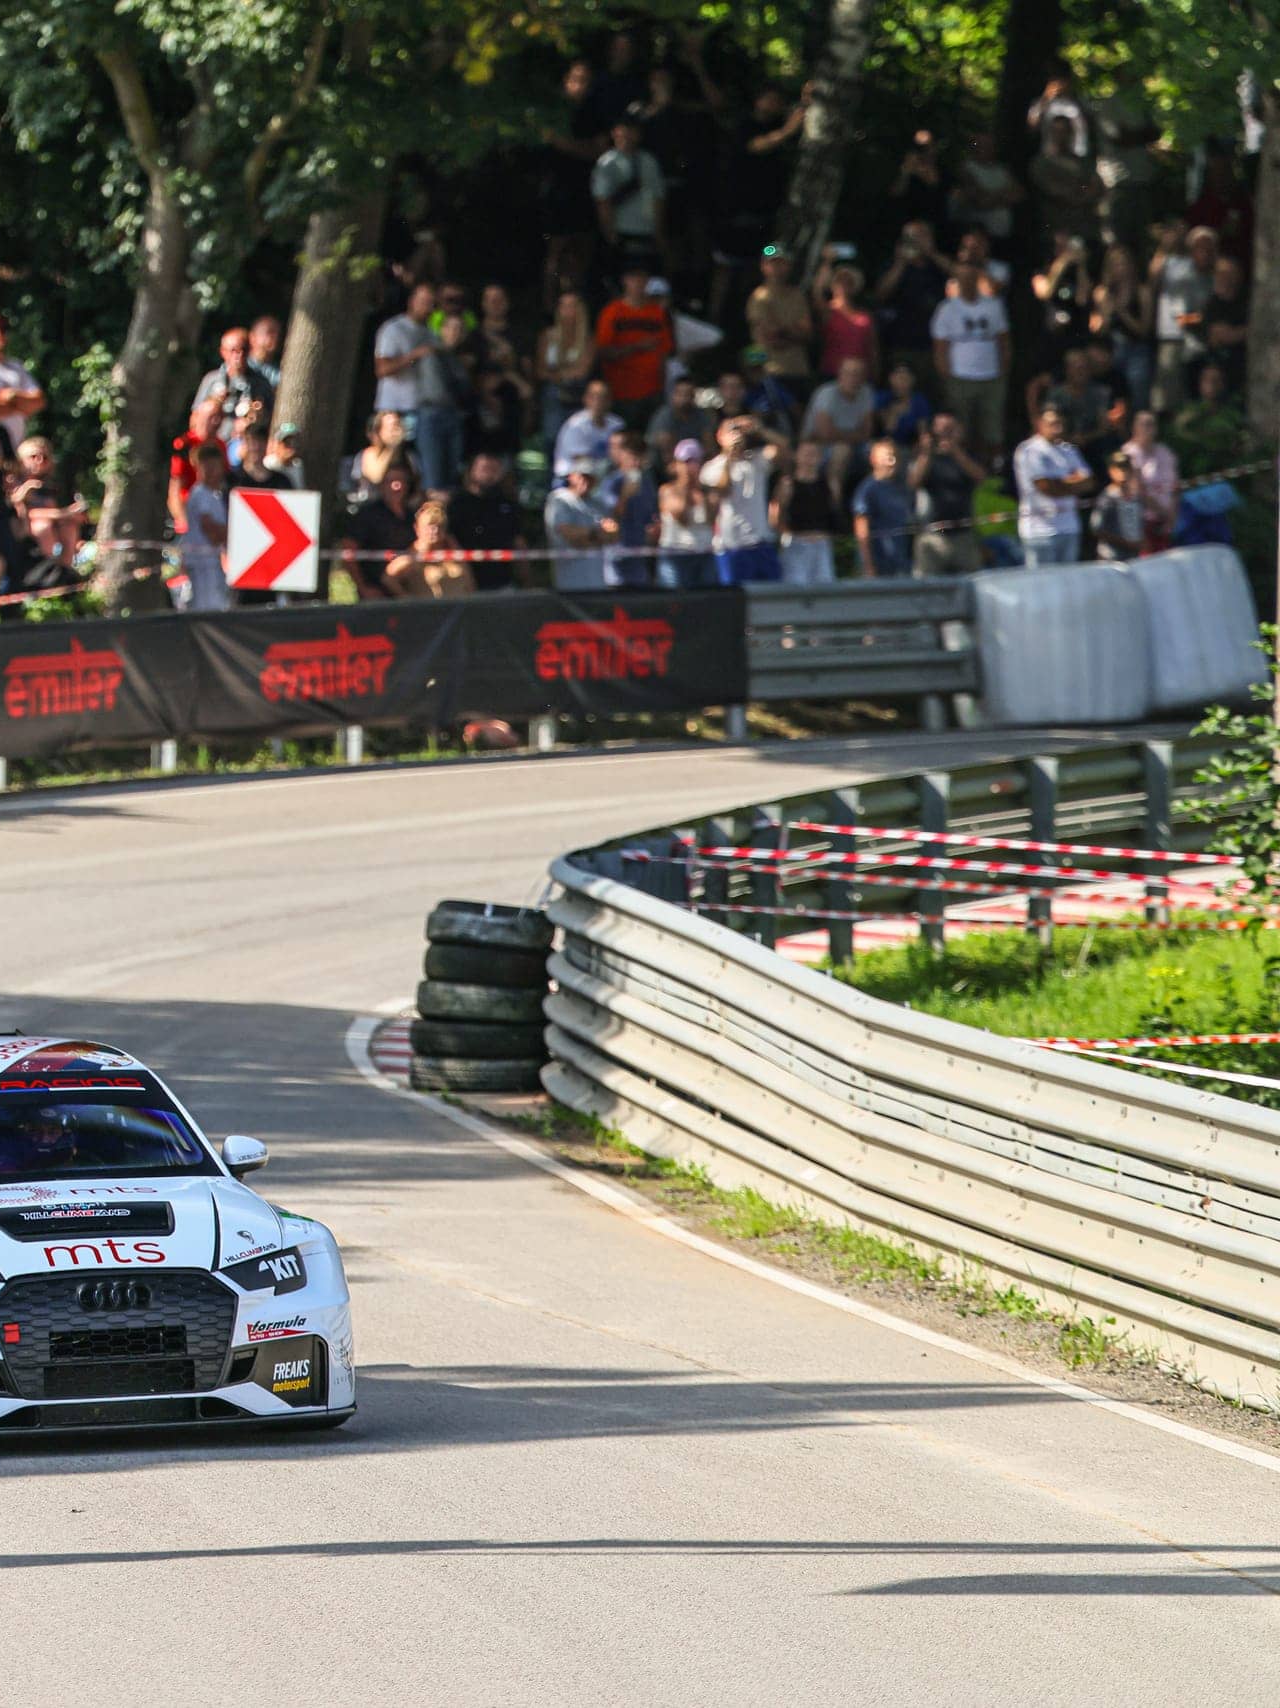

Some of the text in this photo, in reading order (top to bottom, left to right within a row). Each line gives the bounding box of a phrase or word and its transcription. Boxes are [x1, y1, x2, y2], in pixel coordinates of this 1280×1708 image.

[43, 1239, 166, 1268] mts
[268, 1254, 302, 1282] KIT
[251, 1315, 307, 1332] formula
[273, 1359, 311, 1380] FREAKS
[272, 1377, 310, 1393] motorsport
